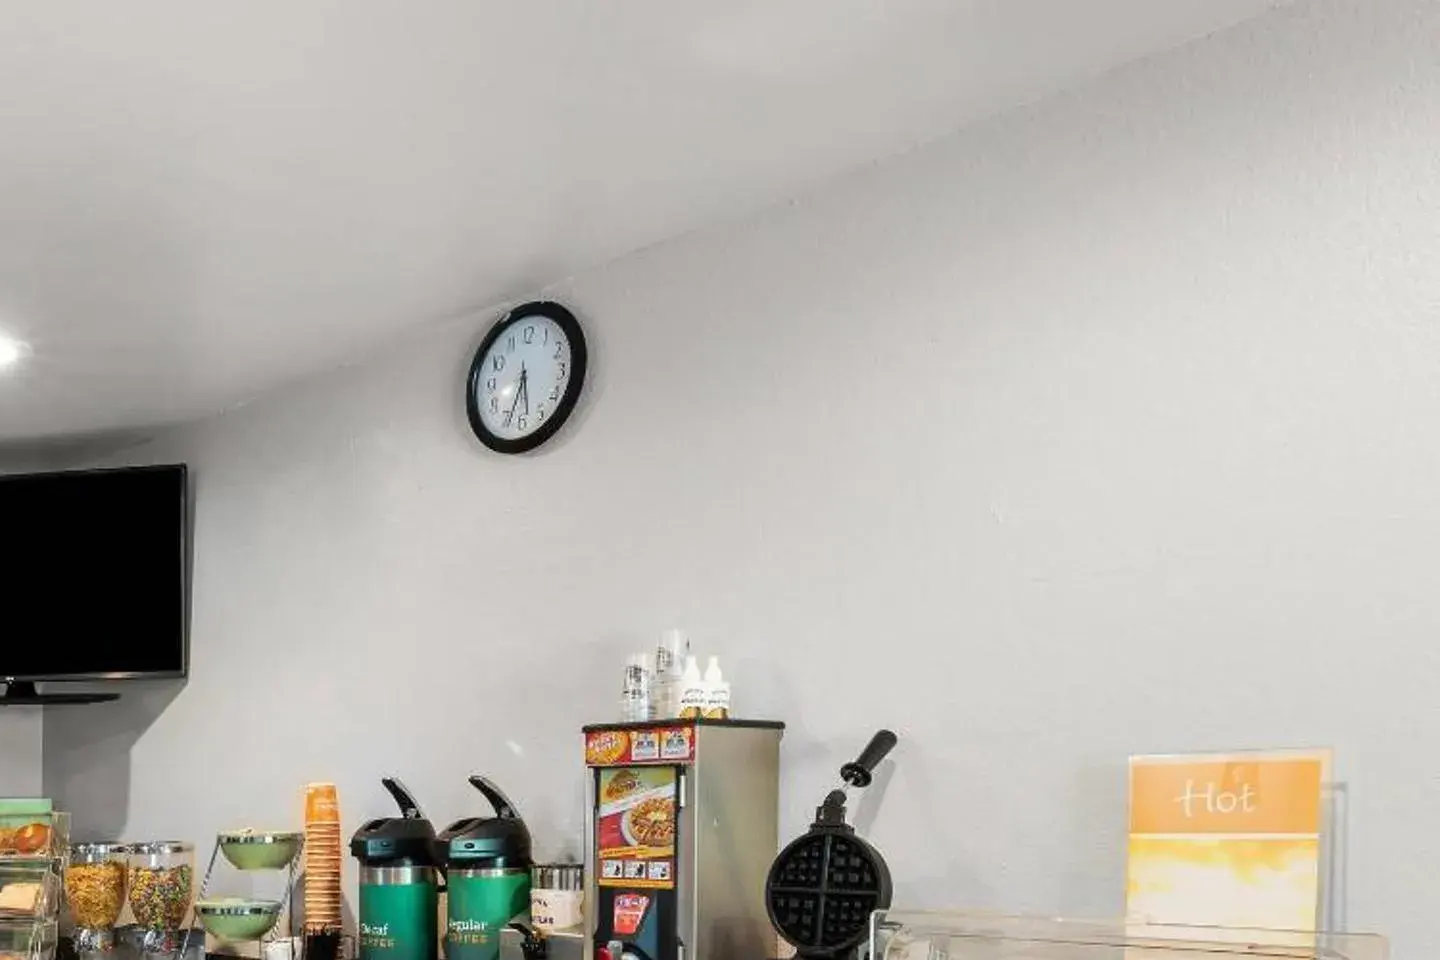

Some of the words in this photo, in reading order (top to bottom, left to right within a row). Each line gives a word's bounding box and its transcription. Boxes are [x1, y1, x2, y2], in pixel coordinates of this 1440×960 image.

[523, 326, 536, 345] 12
[507, 336, 516, 354] 11
[553, 341, 564, 360] 2
[493, 354, 506, 372] 10
[556, 363, 566, 380] 3
[487, 377, 497, 391] 9
[549, 386, 560, 402] 4
[490, 398, 498, 414] 8
[536, 402, 546, 421] 5
[518, 414, 527, 431] 6
[1172, 779, 1257, 818] Hot
